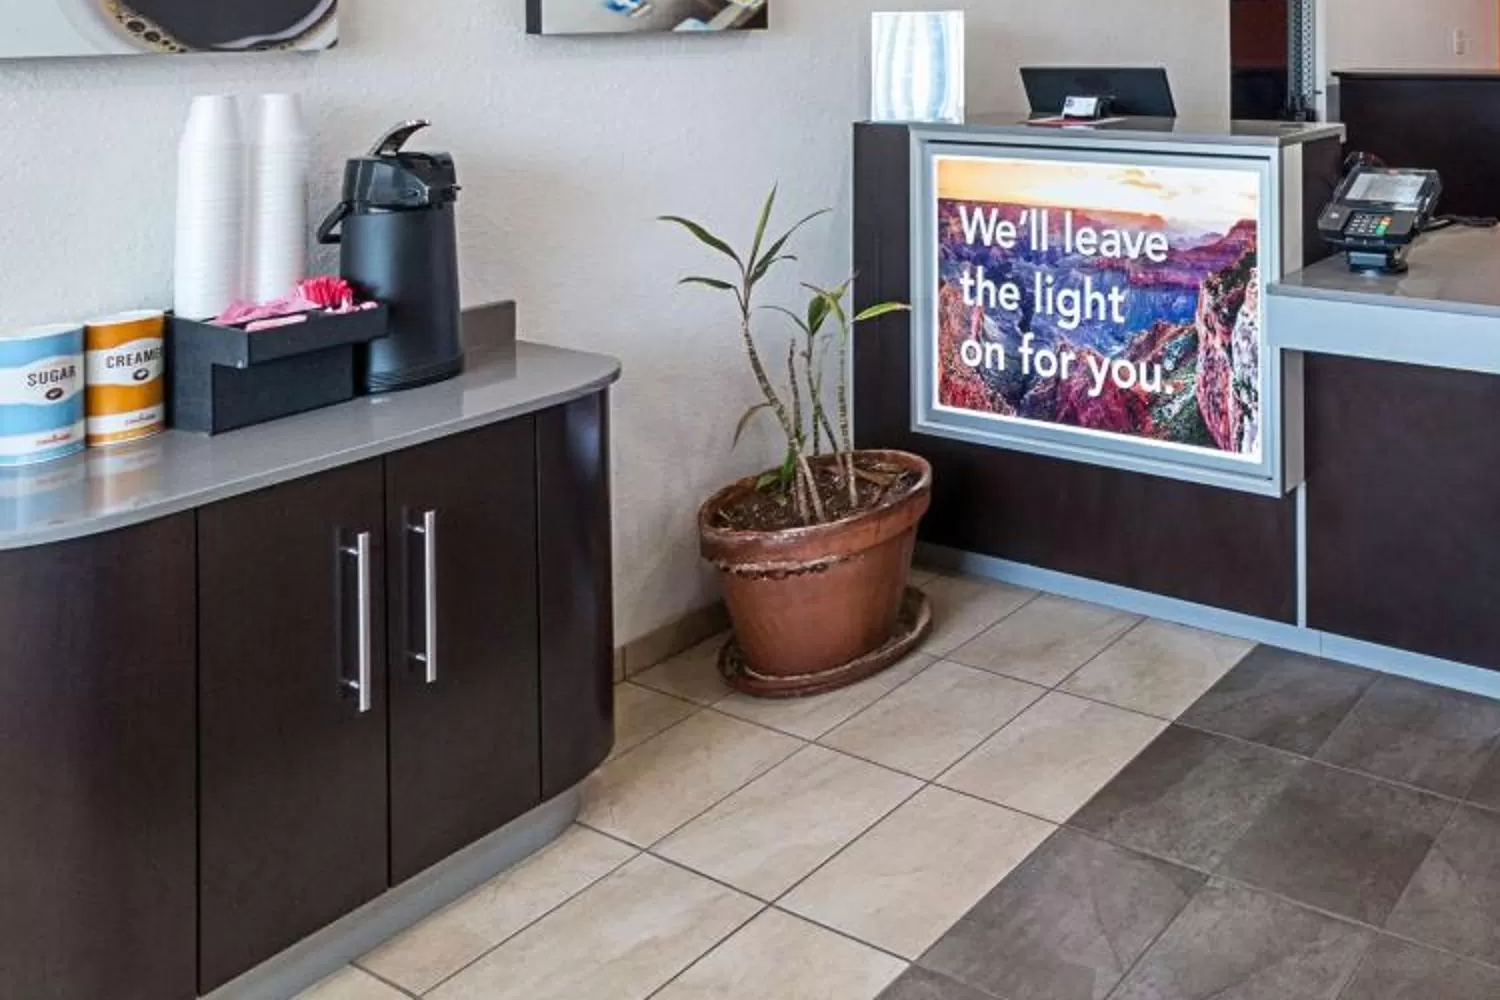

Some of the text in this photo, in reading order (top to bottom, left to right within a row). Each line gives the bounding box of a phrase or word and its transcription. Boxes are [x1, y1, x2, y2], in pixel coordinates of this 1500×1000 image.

[1064, 211, 1169, 262] leave
[960, 266, 1125, 330] the light
[27, 365, 76, 387] SUGAR
[960, 333, 1174, 397] on for you.
